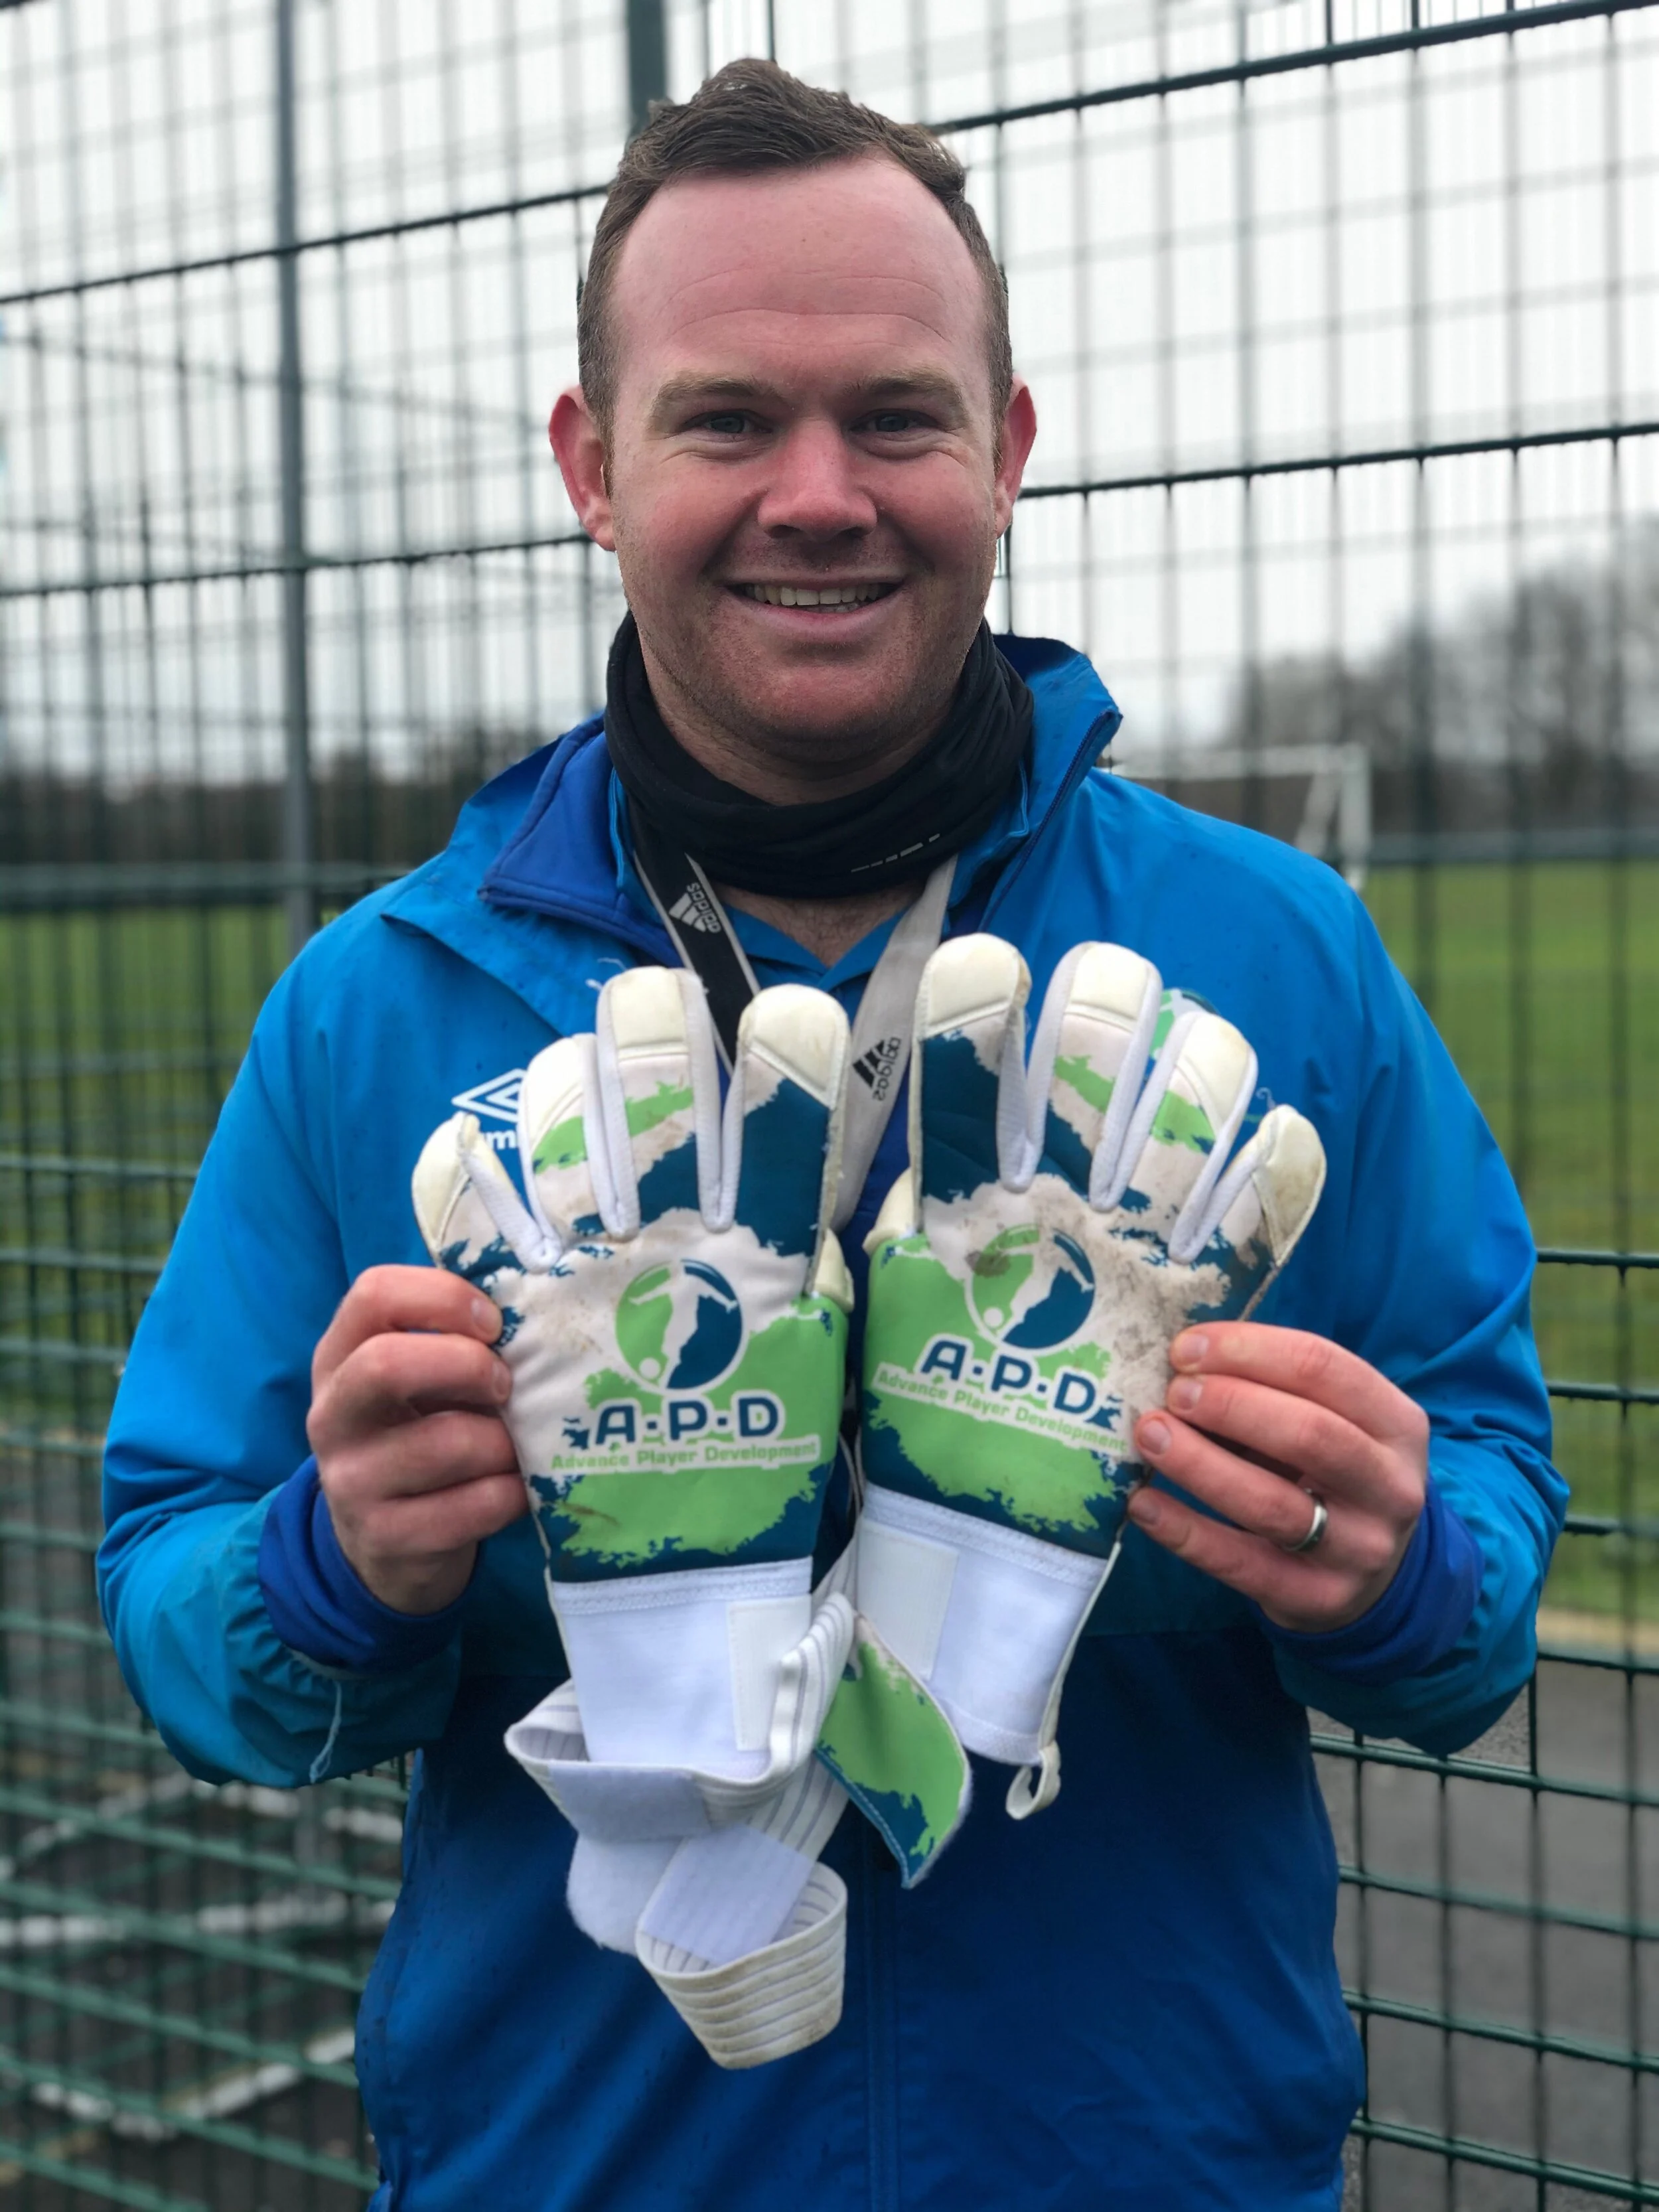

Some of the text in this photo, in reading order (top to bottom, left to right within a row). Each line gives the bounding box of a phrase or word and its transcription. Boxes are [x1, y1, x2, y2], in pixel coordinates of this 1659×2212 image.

[686, 882, 721, 934] adidas
[878, 1370, 1127, 1451] Advance Player Development
[551, 1441, 816, 1469] Advance Player Development
